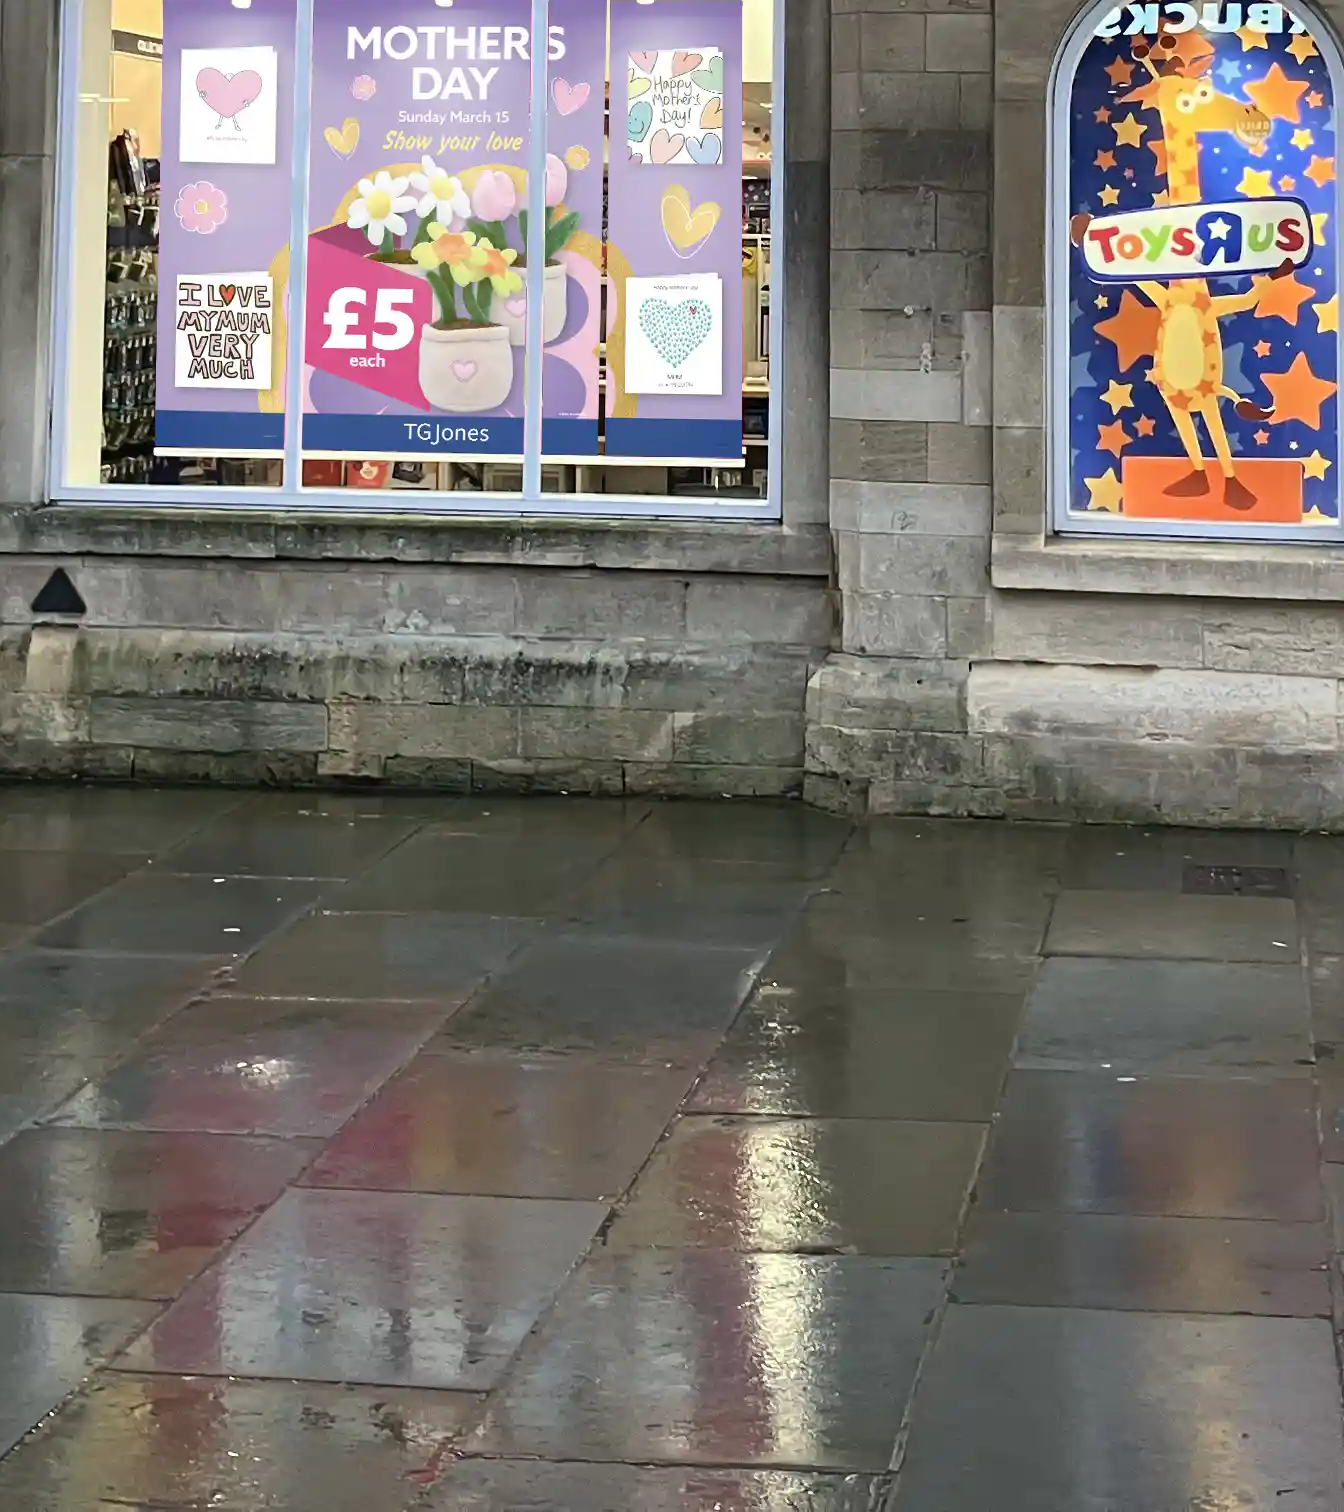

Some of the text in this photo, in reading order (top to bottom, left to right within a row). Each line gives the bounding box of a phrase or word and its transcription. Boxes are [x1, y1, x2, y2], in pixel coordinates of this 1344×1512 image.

[347, 25, 566, 61] MOTHERS
[412, 66, 500, 101] DAY
[654, 76, 692, 96] Happy
[398, 110, 510, 126] Sunday March 15
[660, 108, 692, 128] Day!
[383, 129, 524, 156] Show your love
[179, 283, 202, 306] I
[321, 286, 415, 351] £5
[188, 333, 259, 360] VERY
[188, 358, 254, 380] MUCH
[349, 353, 386, 368] each
